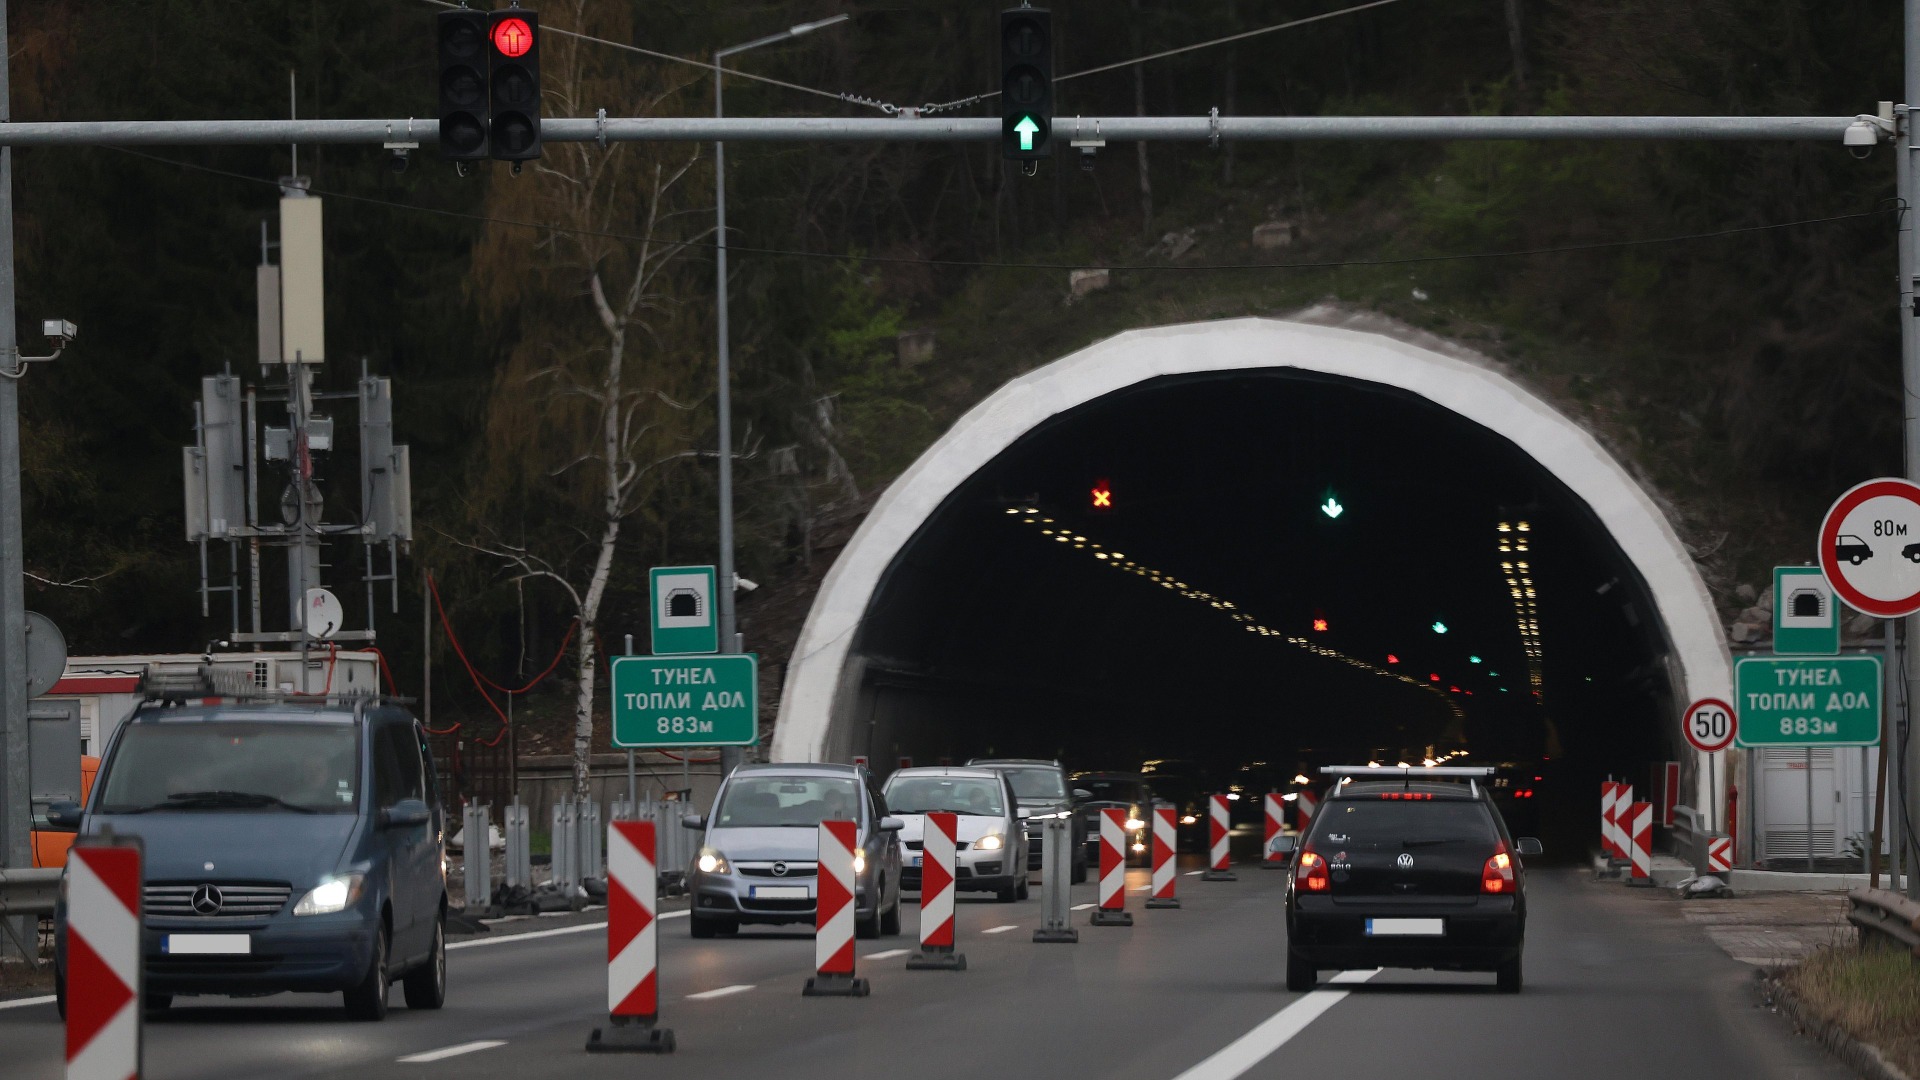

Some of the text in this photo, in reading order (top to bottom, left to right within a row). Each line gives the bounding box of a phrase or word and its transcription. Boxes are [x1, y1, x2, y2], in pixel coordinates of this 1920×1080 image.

[651, 667, 717, 685] ТУНЕЛ
[1774, 668, 1842, 686] ТУНЕЛ
[624, 691, 745, 711] ТОПЛИ ДОЛ
[1747, 691, 1871, 712] ТОПЛИ ДОЛ
[657, 716, 713, 734] 883м
[1695, 712, 1726, 738] 50
[1779, 716, 1838, 736] 883м
